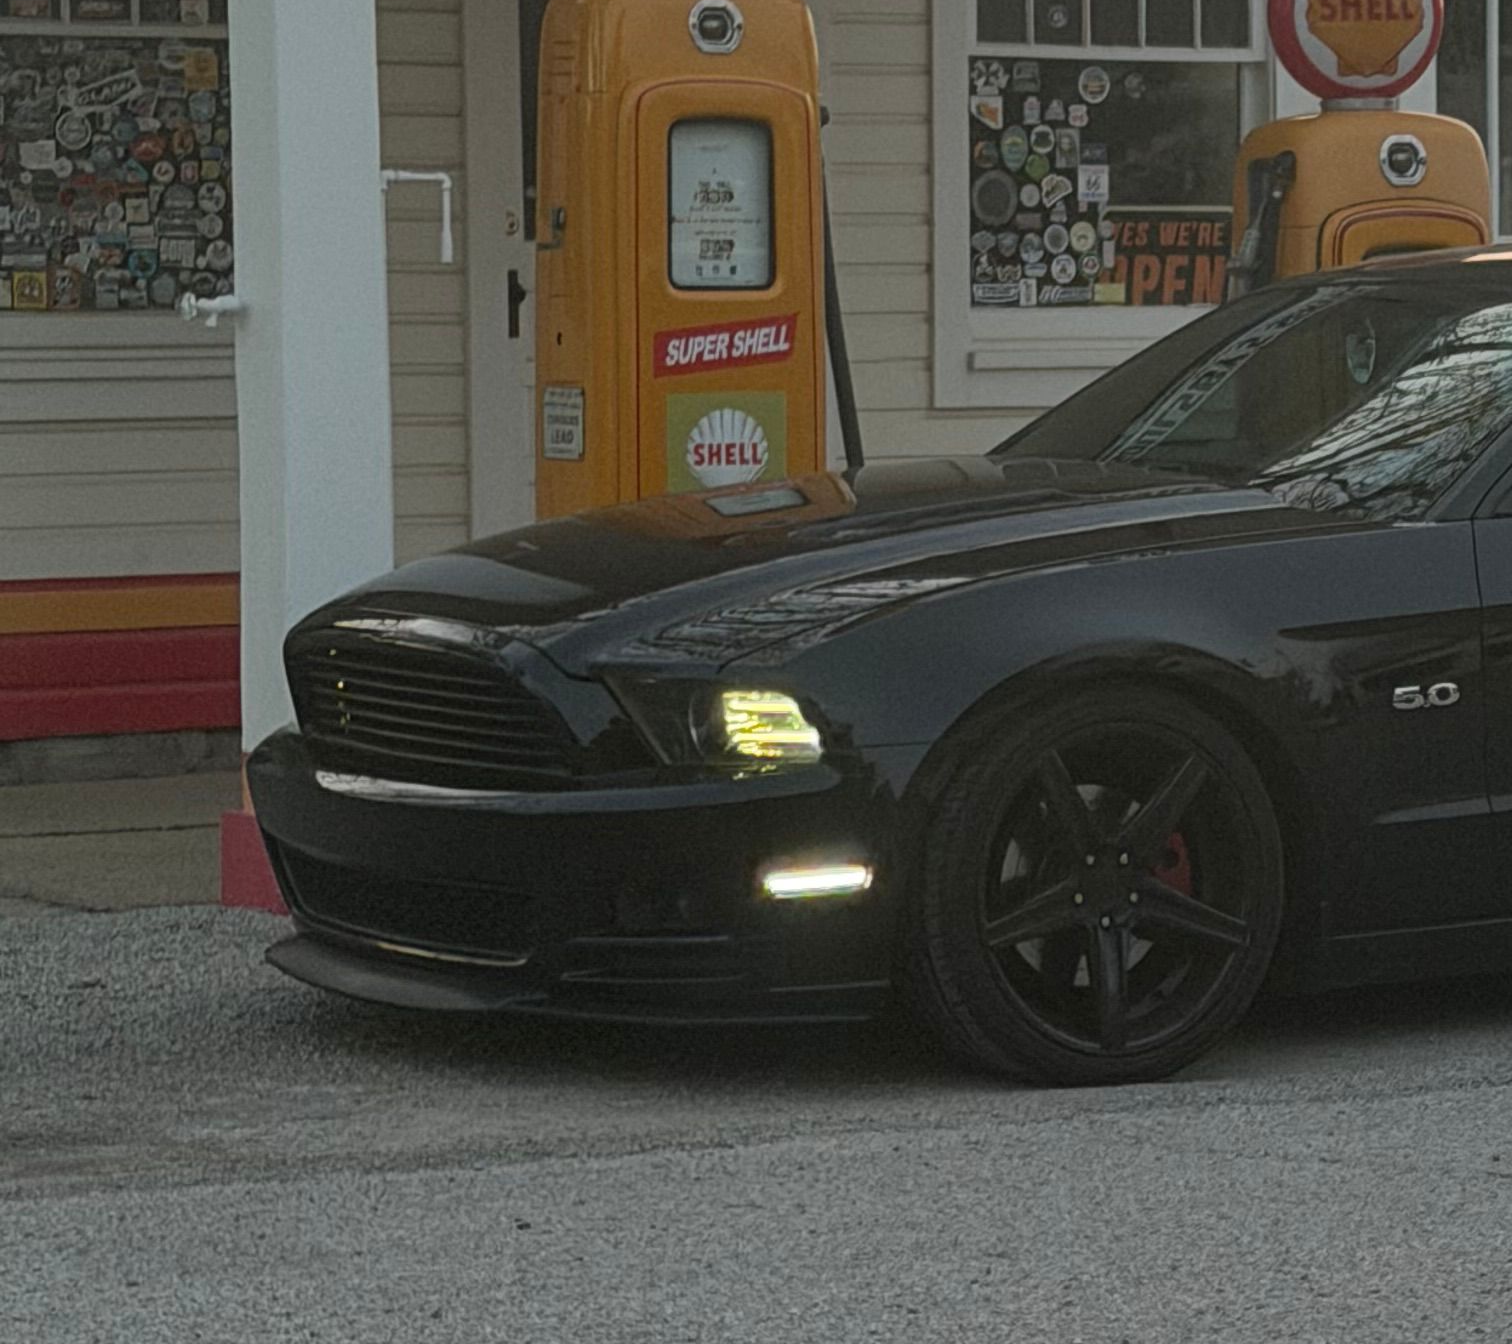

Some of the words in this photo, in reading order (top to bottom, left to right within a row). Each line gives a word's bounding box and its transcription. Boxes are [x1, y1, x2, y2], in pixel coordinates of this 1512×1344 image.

[1159, 221, 1225, 247] WE'RE
[665, 331, 731, 367] SUPER
[732, 324, 790, 358] SHELL
[693, 441, 763, 467] SHELL
[1392, 682, 1460, 710] 5.0
